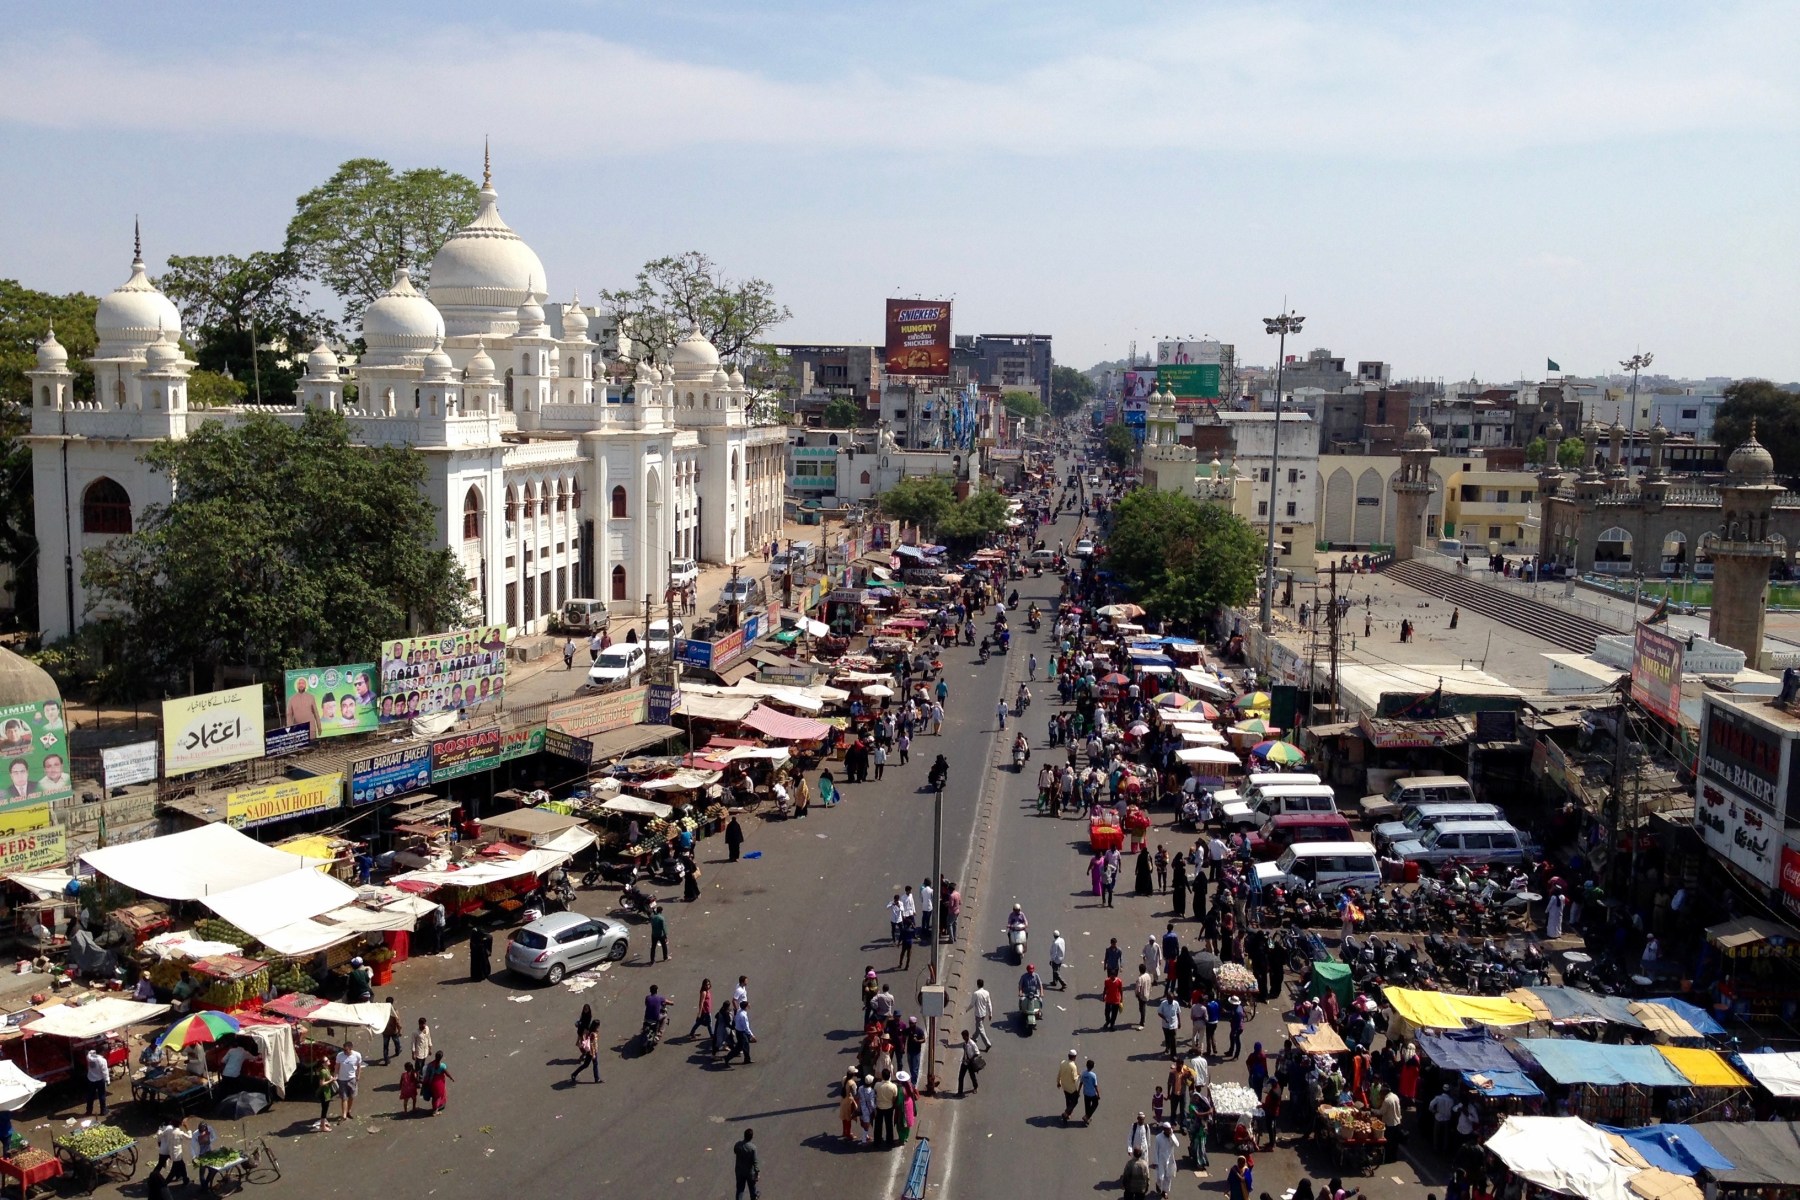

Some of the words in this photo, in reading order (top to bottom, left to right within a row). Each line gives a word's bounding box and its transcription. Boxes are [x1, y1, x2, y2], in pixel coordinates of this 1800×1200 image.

[900, 309, 939, 321] SNICKERS
[901, 324, 937, 333] HUNGRY?
[444, 640, 452, 649] 58
[608, 705, 629, 721] HOTEL
[186, 716, 241, 750] اعتماد
[433, 729, 499, 756] ROSHAN
[506, 742, 526, 752] SHOP
[353, 760, 372, 775] ABUL
[373, 752, 403, 770] BARKAAT
[403, 745, 429, 762] BAKERY
[438, 751, 465, 764] Sweet
[468, 745, 495, 758] House
[1733, 765, 1778, 806] BAKERY
[246, 796, 291, 819] SADDAM
[293, 790, 326, 809] HOTEL
[37, 829, 63, 840] GENERAL
[41, 838, 59, 847] STORE
[10, 852, 28, 862] COOL
[29, 847, 49, 858] POINT
